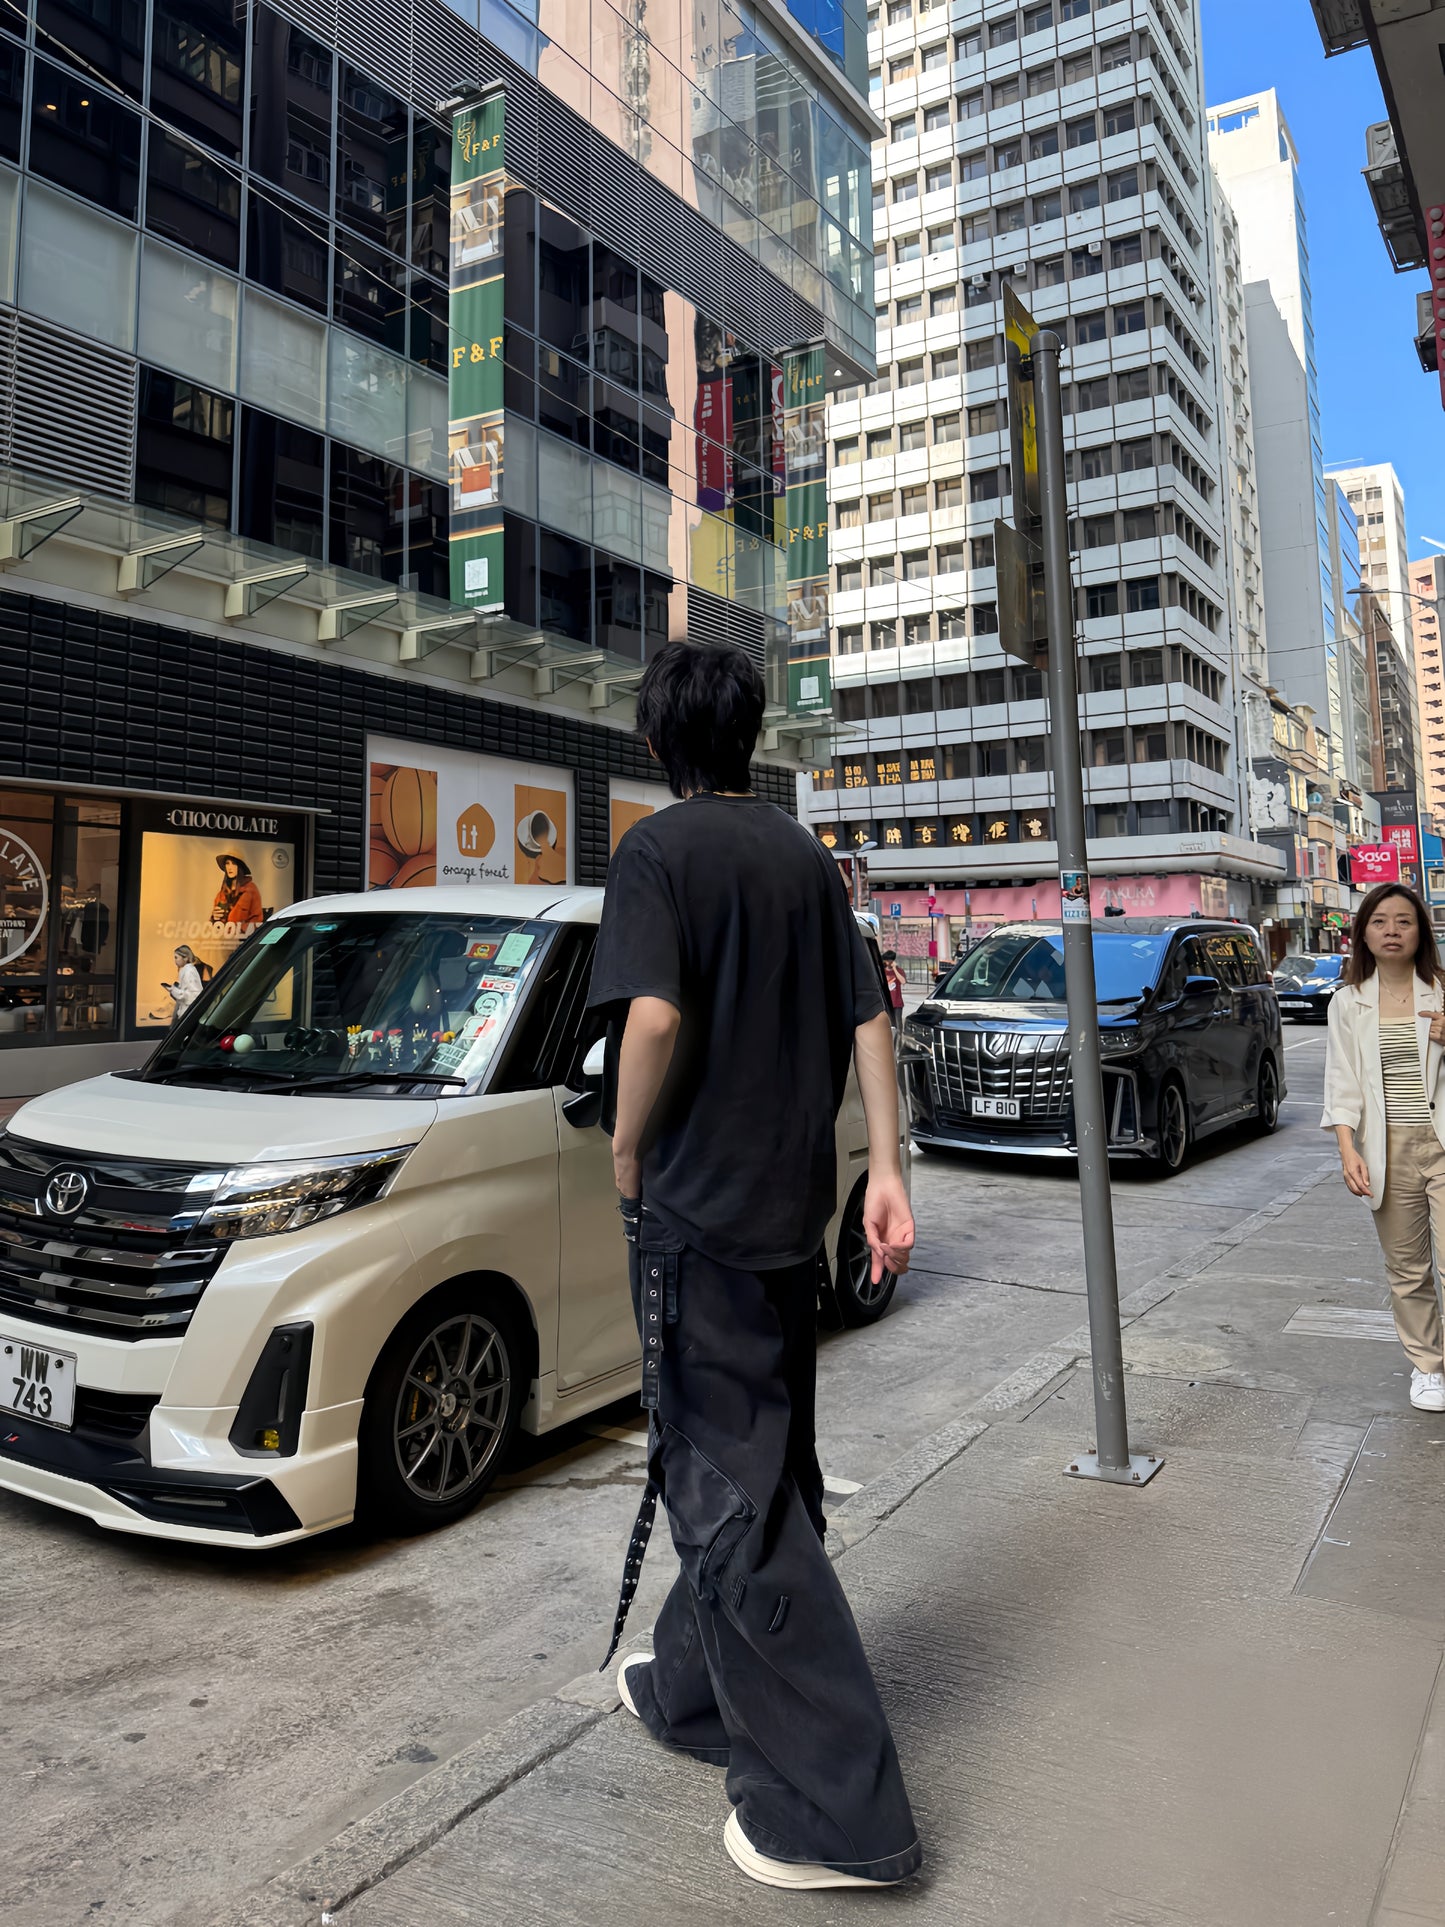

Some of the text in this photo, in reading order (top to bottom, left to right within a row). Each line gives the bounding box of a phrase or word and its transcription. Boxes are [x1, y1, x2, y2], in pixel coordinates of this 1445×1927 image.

[845, 776, 868, 788] SPA
[892, 904, 900, 914] P
[975, 1100, 1017, 1115] LF 810
[20, 1346, 50, 1385] WW
[12, 1377, 52, 1418] 743
